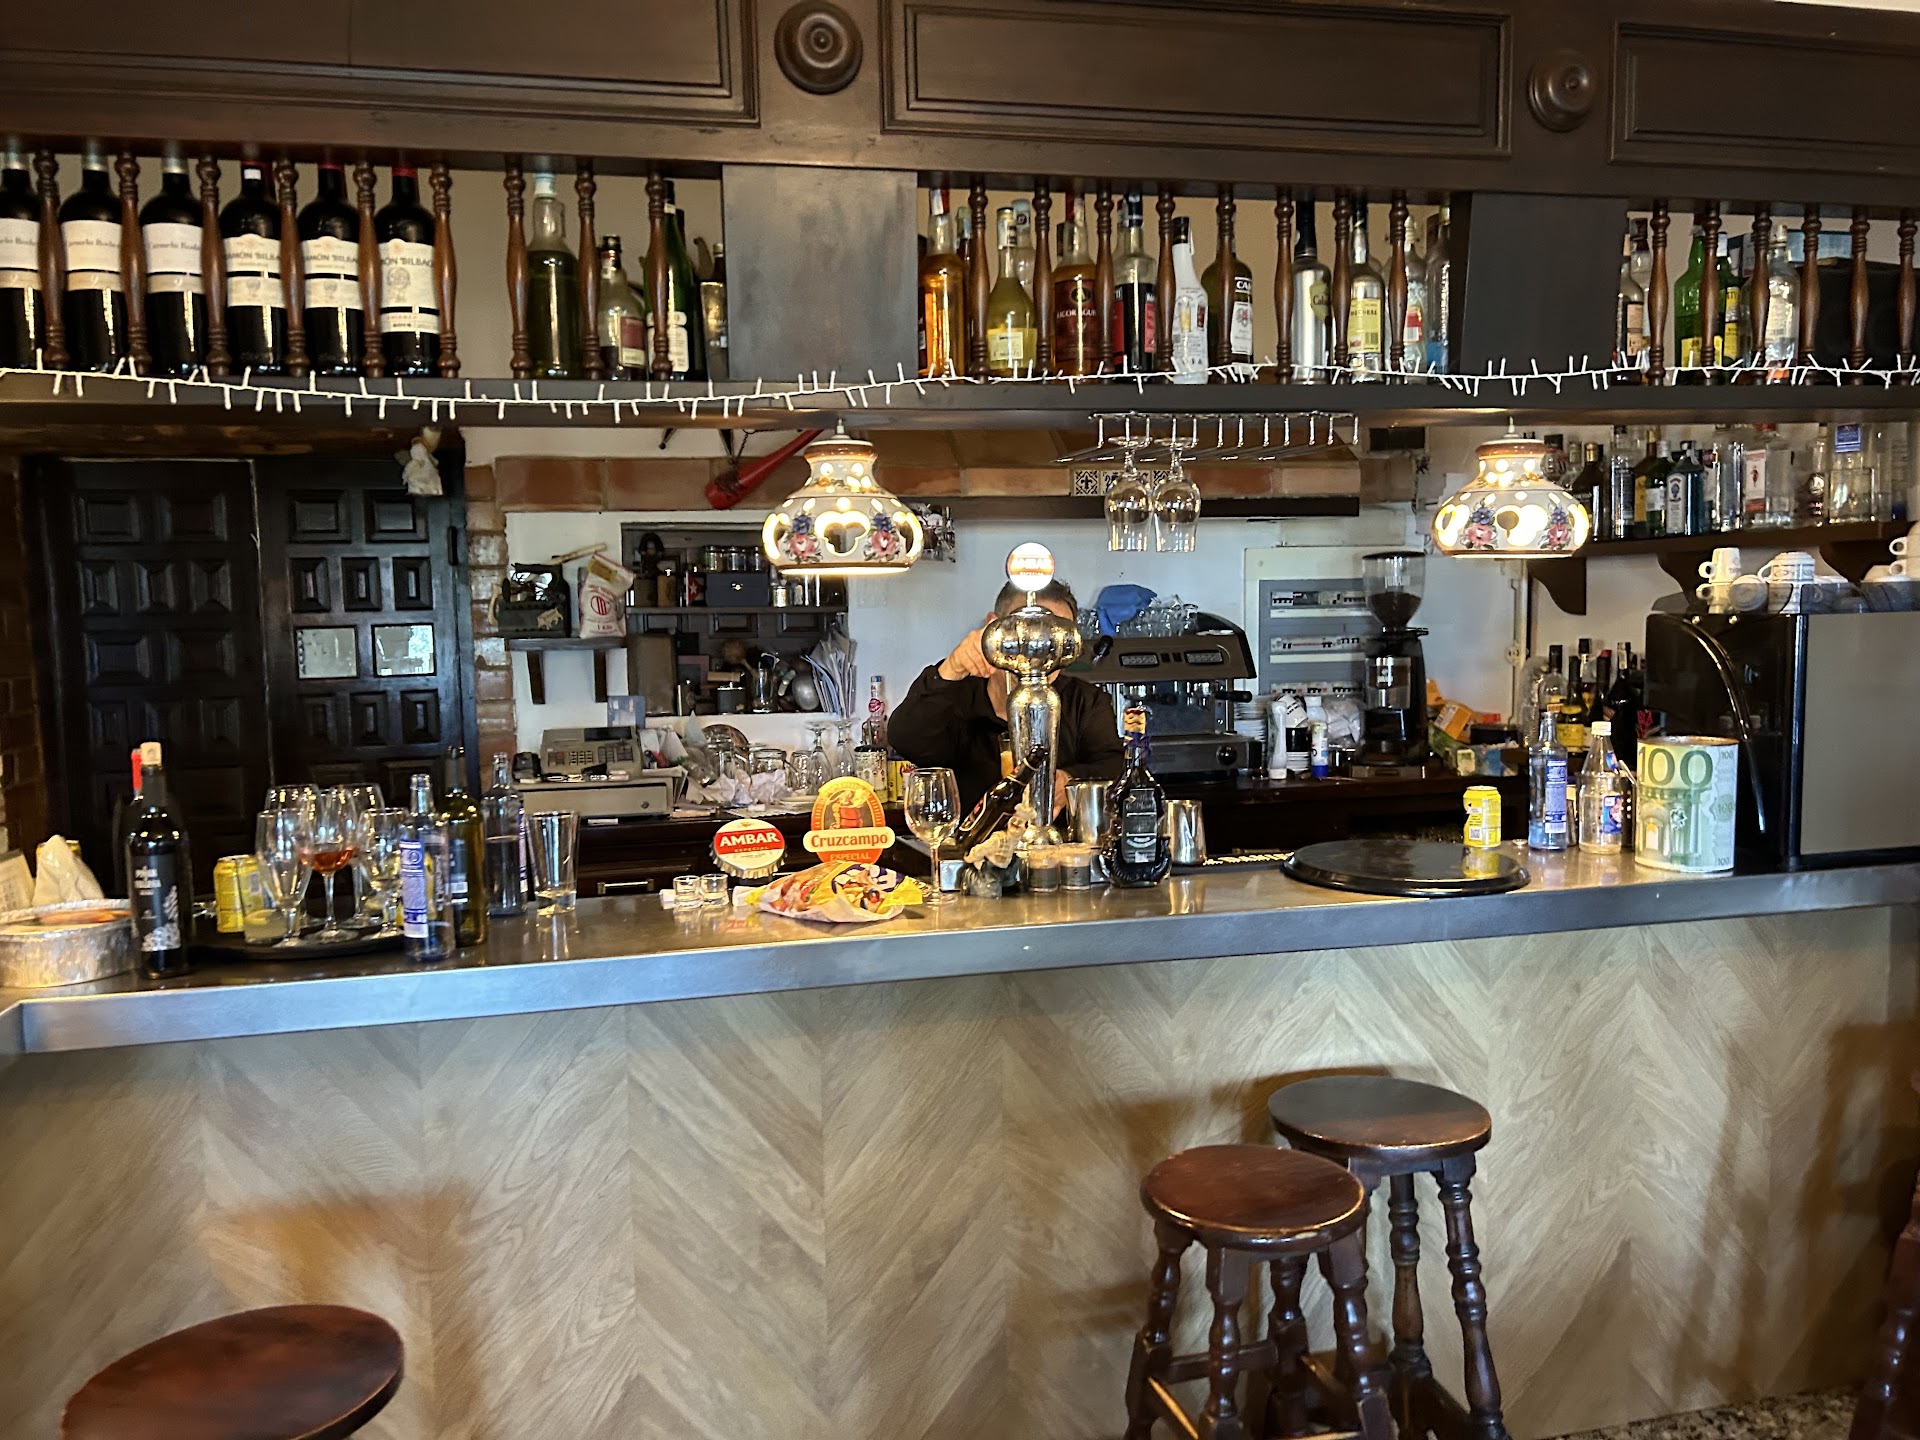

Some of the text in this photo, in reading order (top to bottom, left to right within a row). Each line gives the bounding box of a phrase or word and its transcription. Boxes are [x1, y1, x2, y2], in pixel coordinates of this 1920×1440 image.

[1721, 750, 1734, 760] 100
[1638, 746, 1714, 789] 100
[719, 831, 781, 847] AMBAR
[811, 833, 888, 849] Cruzcampo
[830, 852, 871, 861] ESPECIAL
[1718, 857, 1730, 865] 100
